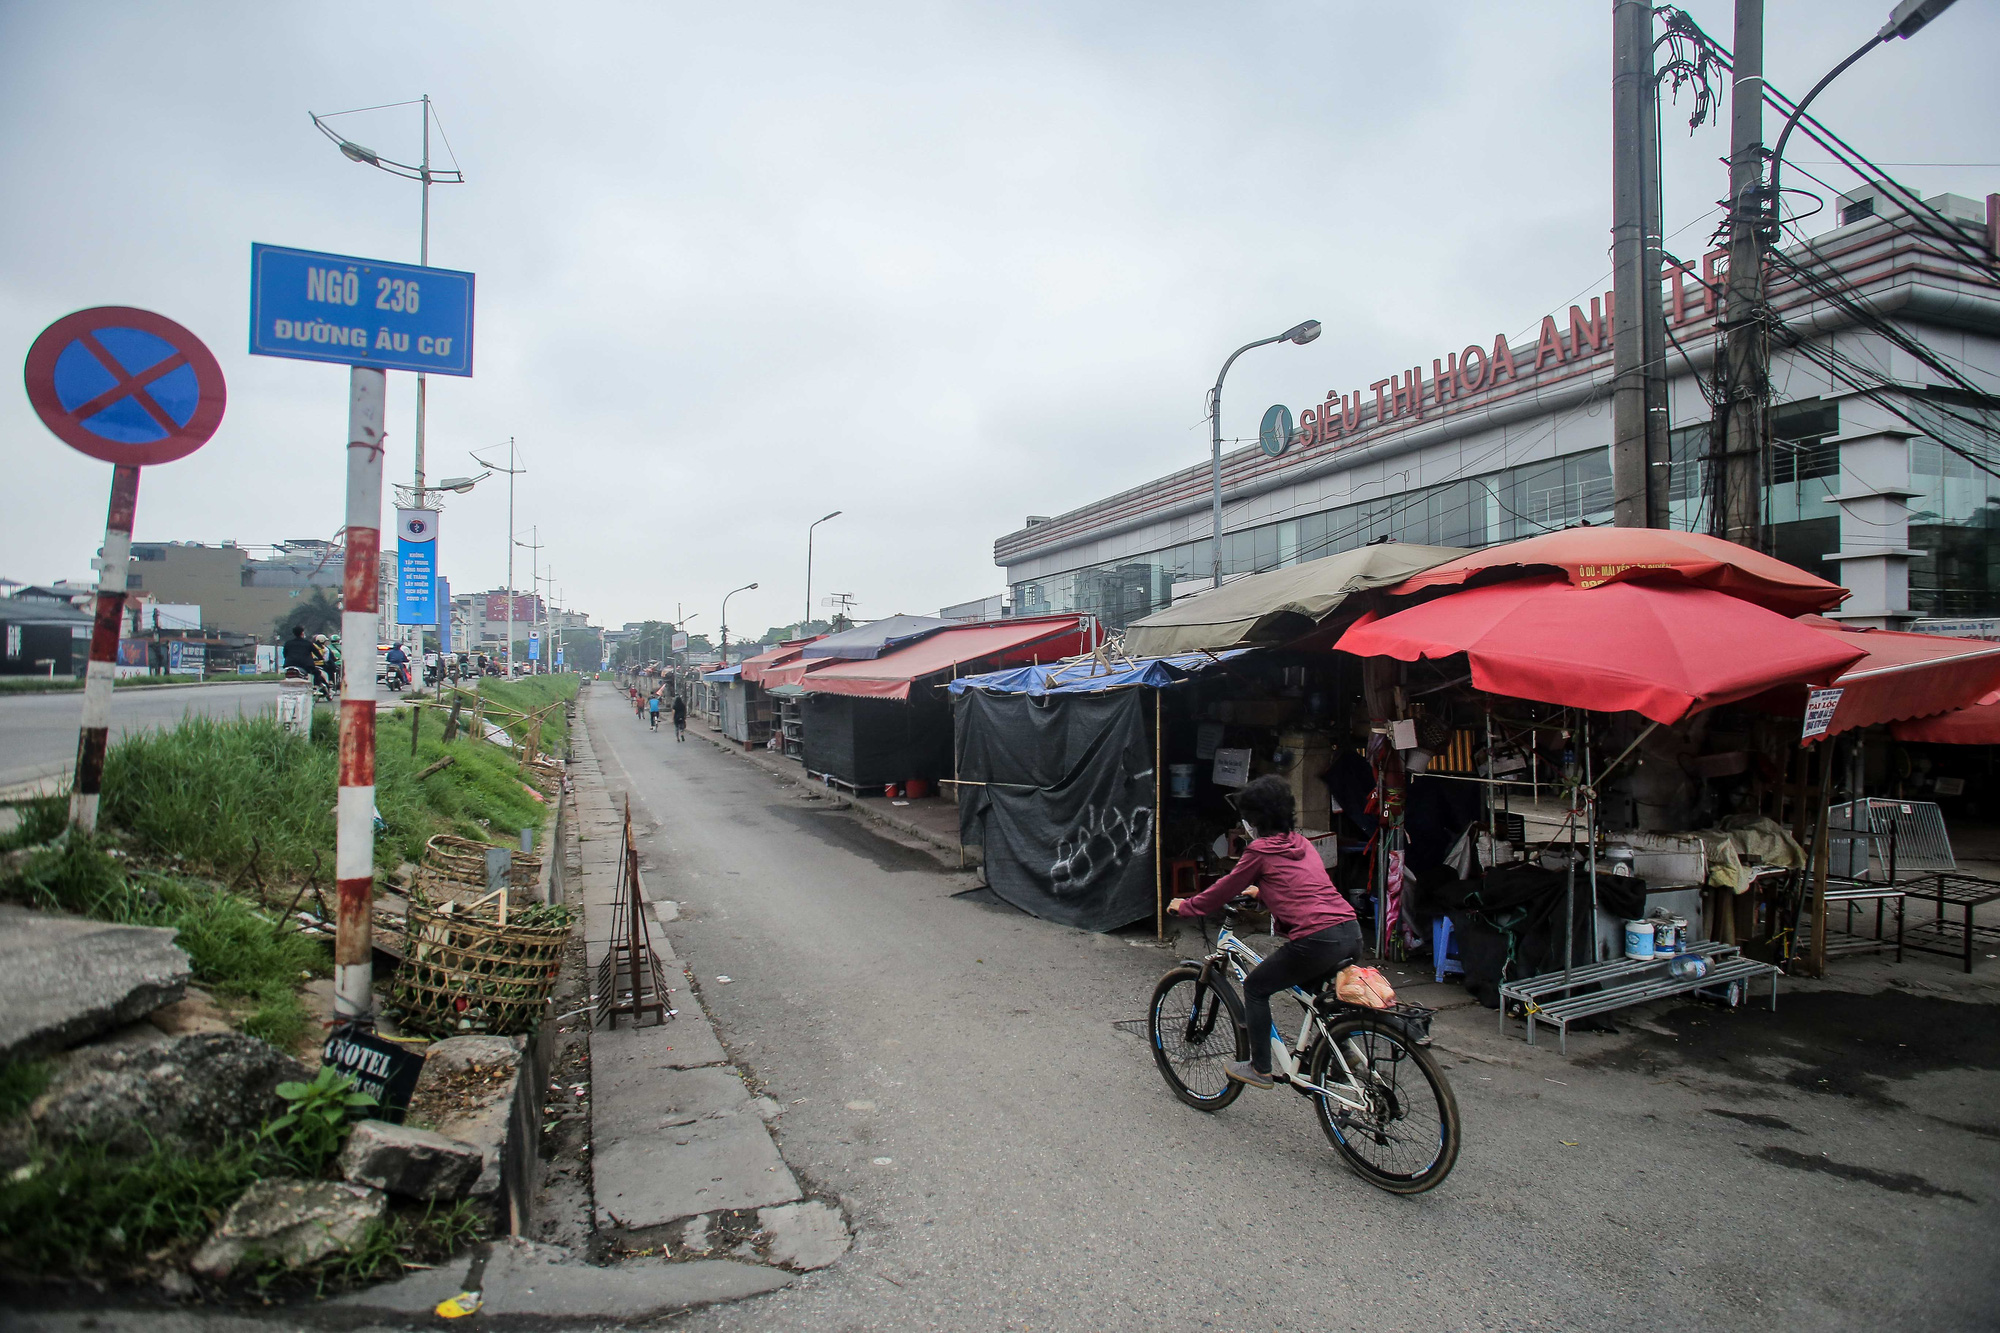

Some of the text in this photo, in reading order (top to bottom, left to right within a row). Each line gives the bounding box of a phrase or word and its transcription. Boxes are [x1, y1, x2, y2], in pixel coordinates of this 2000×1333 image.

[307, 266, 420, 314] NGÕ 236
[274, 317, 452, 356] ĐƯỜNG ÂU CƠ
[1299, 390, 1360, 446] SIÊU
[1370, 366, 1423, 419] THỊ
[1433, 333, 1517, 403] HOA
